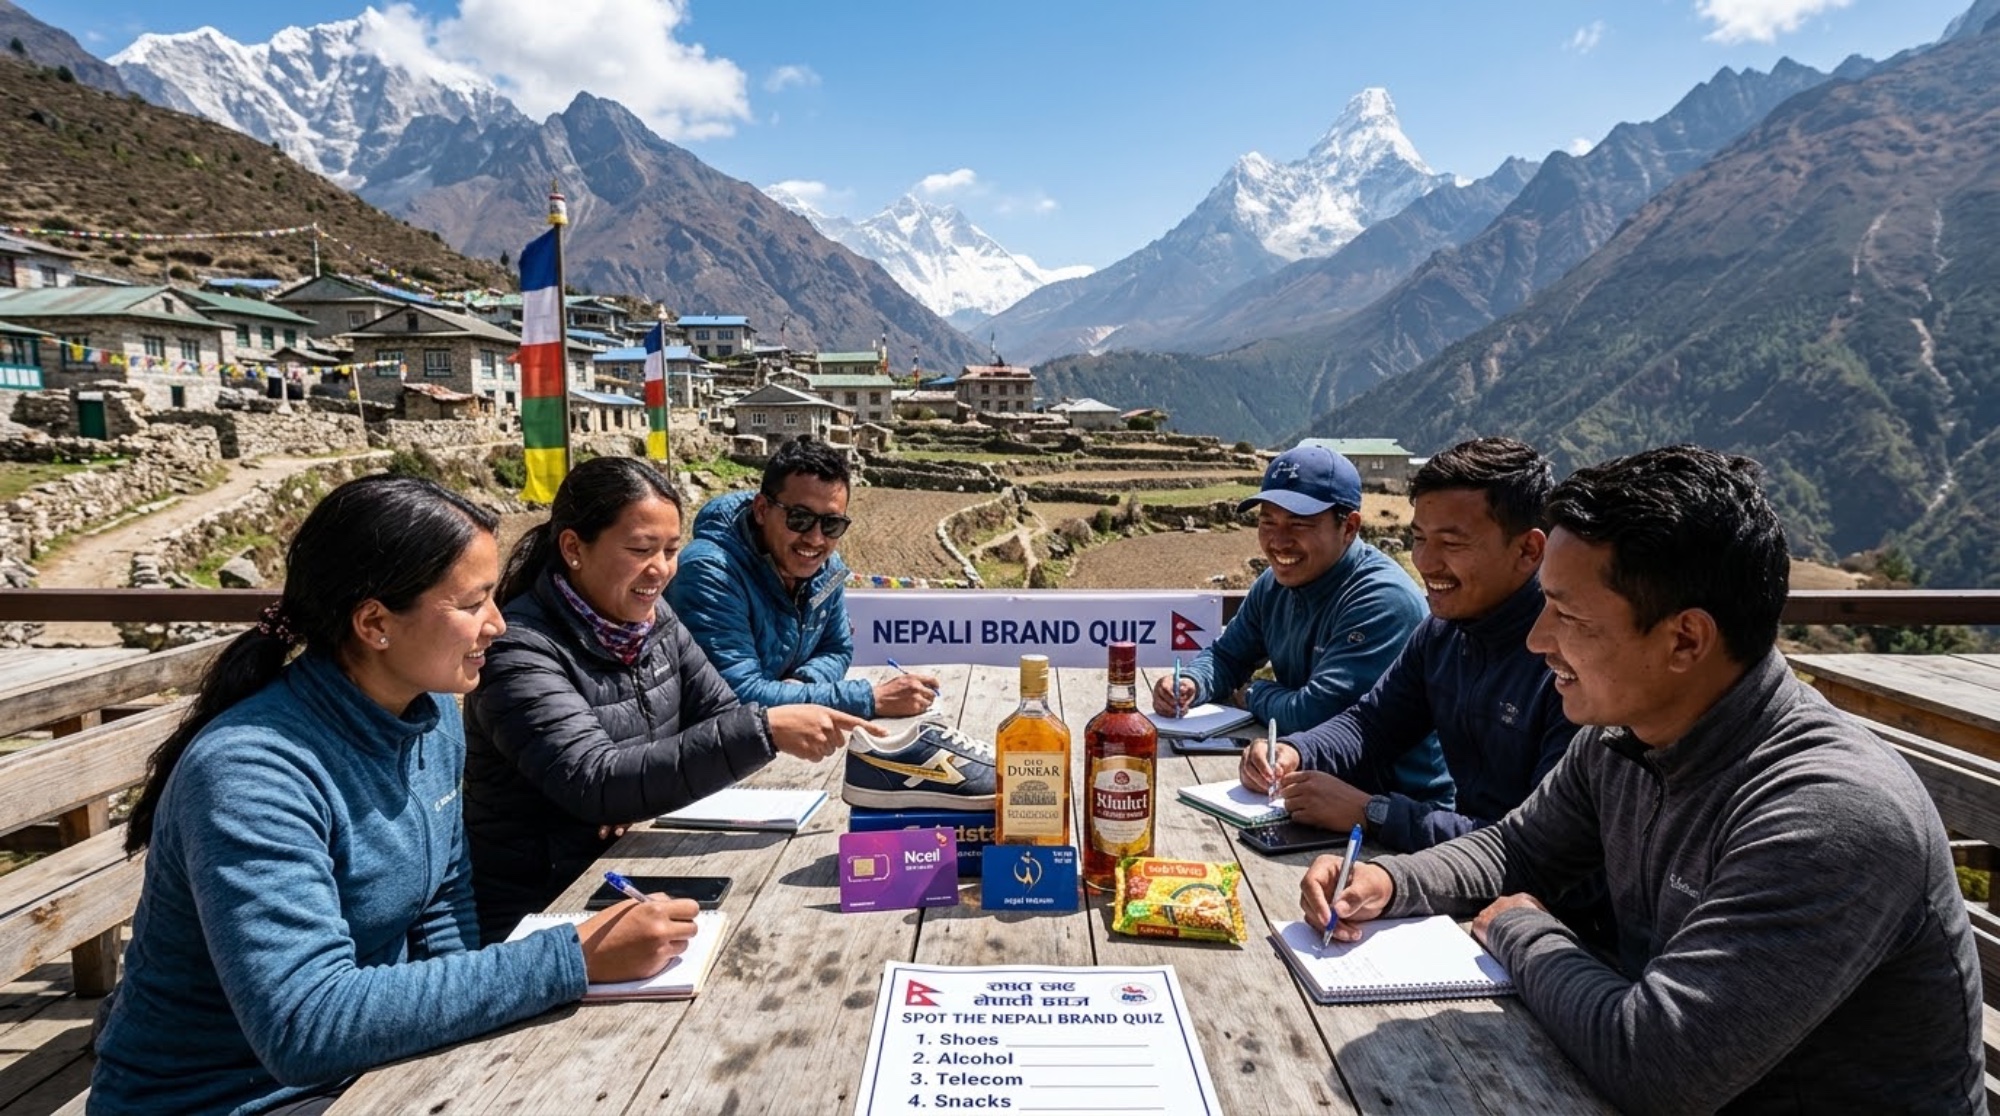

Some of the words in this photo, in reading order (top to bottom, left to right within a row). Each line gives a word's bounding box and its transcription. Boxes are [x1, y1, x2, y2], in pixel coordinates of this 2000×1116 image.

[873, 619, 972, 644] NEPALI
[981, 619, 1080, 645] BRAND
[1089, 619, 1157, 647] QUIZ
[1007, 765, 1060, 777] DUNEAR
[902, 1012, 947, 1024] SPOT
[953, 1013, 987, 1024] THE
[992, 1013, 1052, 1024] NEPALI
[1058, 1013, 1118, 1024] BRAND
[1122, 1013, 1165, 1025] QUIZ
[916, 1033, 932, 1045] 1.
[939, 1033, 999, 1045] Shoes
[912, 1052, 930, 1064] 2.
[937, 1052, 1013, 1065] Alcohol
[910, 1072, 928, 1085] 3.
[936, 1072, 1023, 1086] Telecom
[907, 1093, 926, 1107] 4.
[934, 1093, 1012, 1108] Snacks
